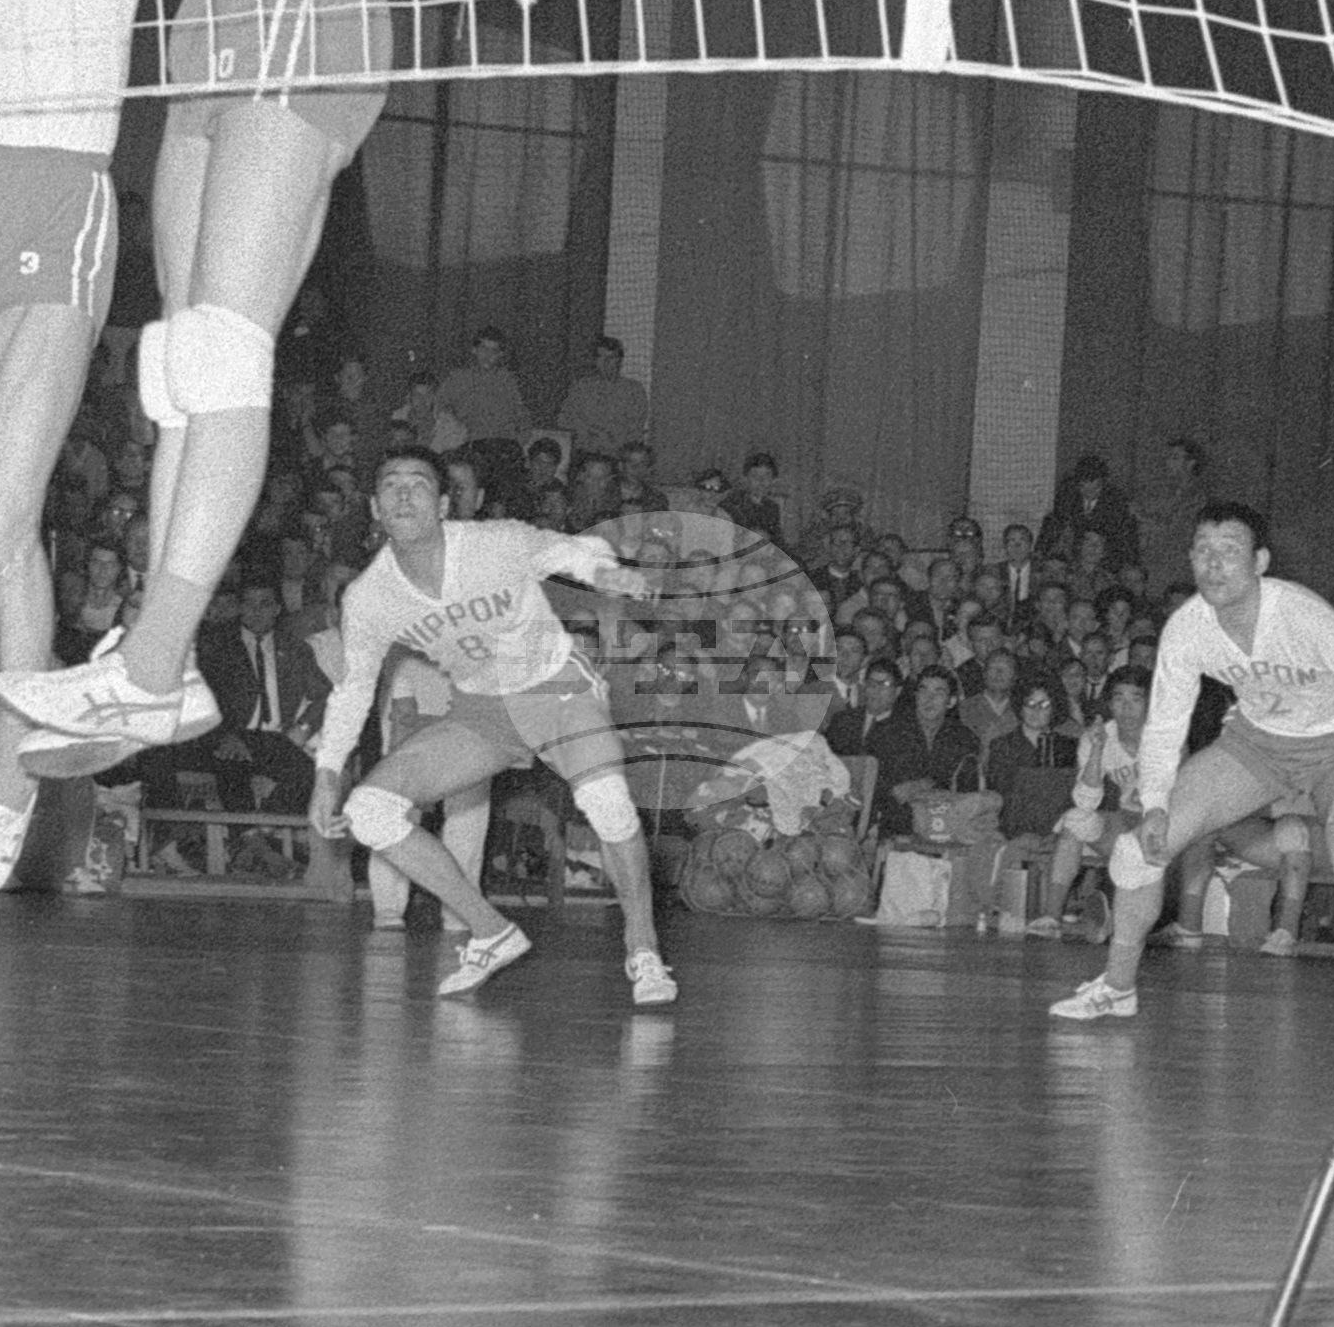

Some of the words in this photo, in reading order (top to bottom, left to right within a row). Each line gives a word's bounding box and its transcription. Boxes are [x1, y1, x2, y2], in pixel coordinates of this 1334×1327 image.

[19, 251, 40, 274] 3
[396, 588, 512, 649] NIPPON
[457, 635, 492, 661] 8
